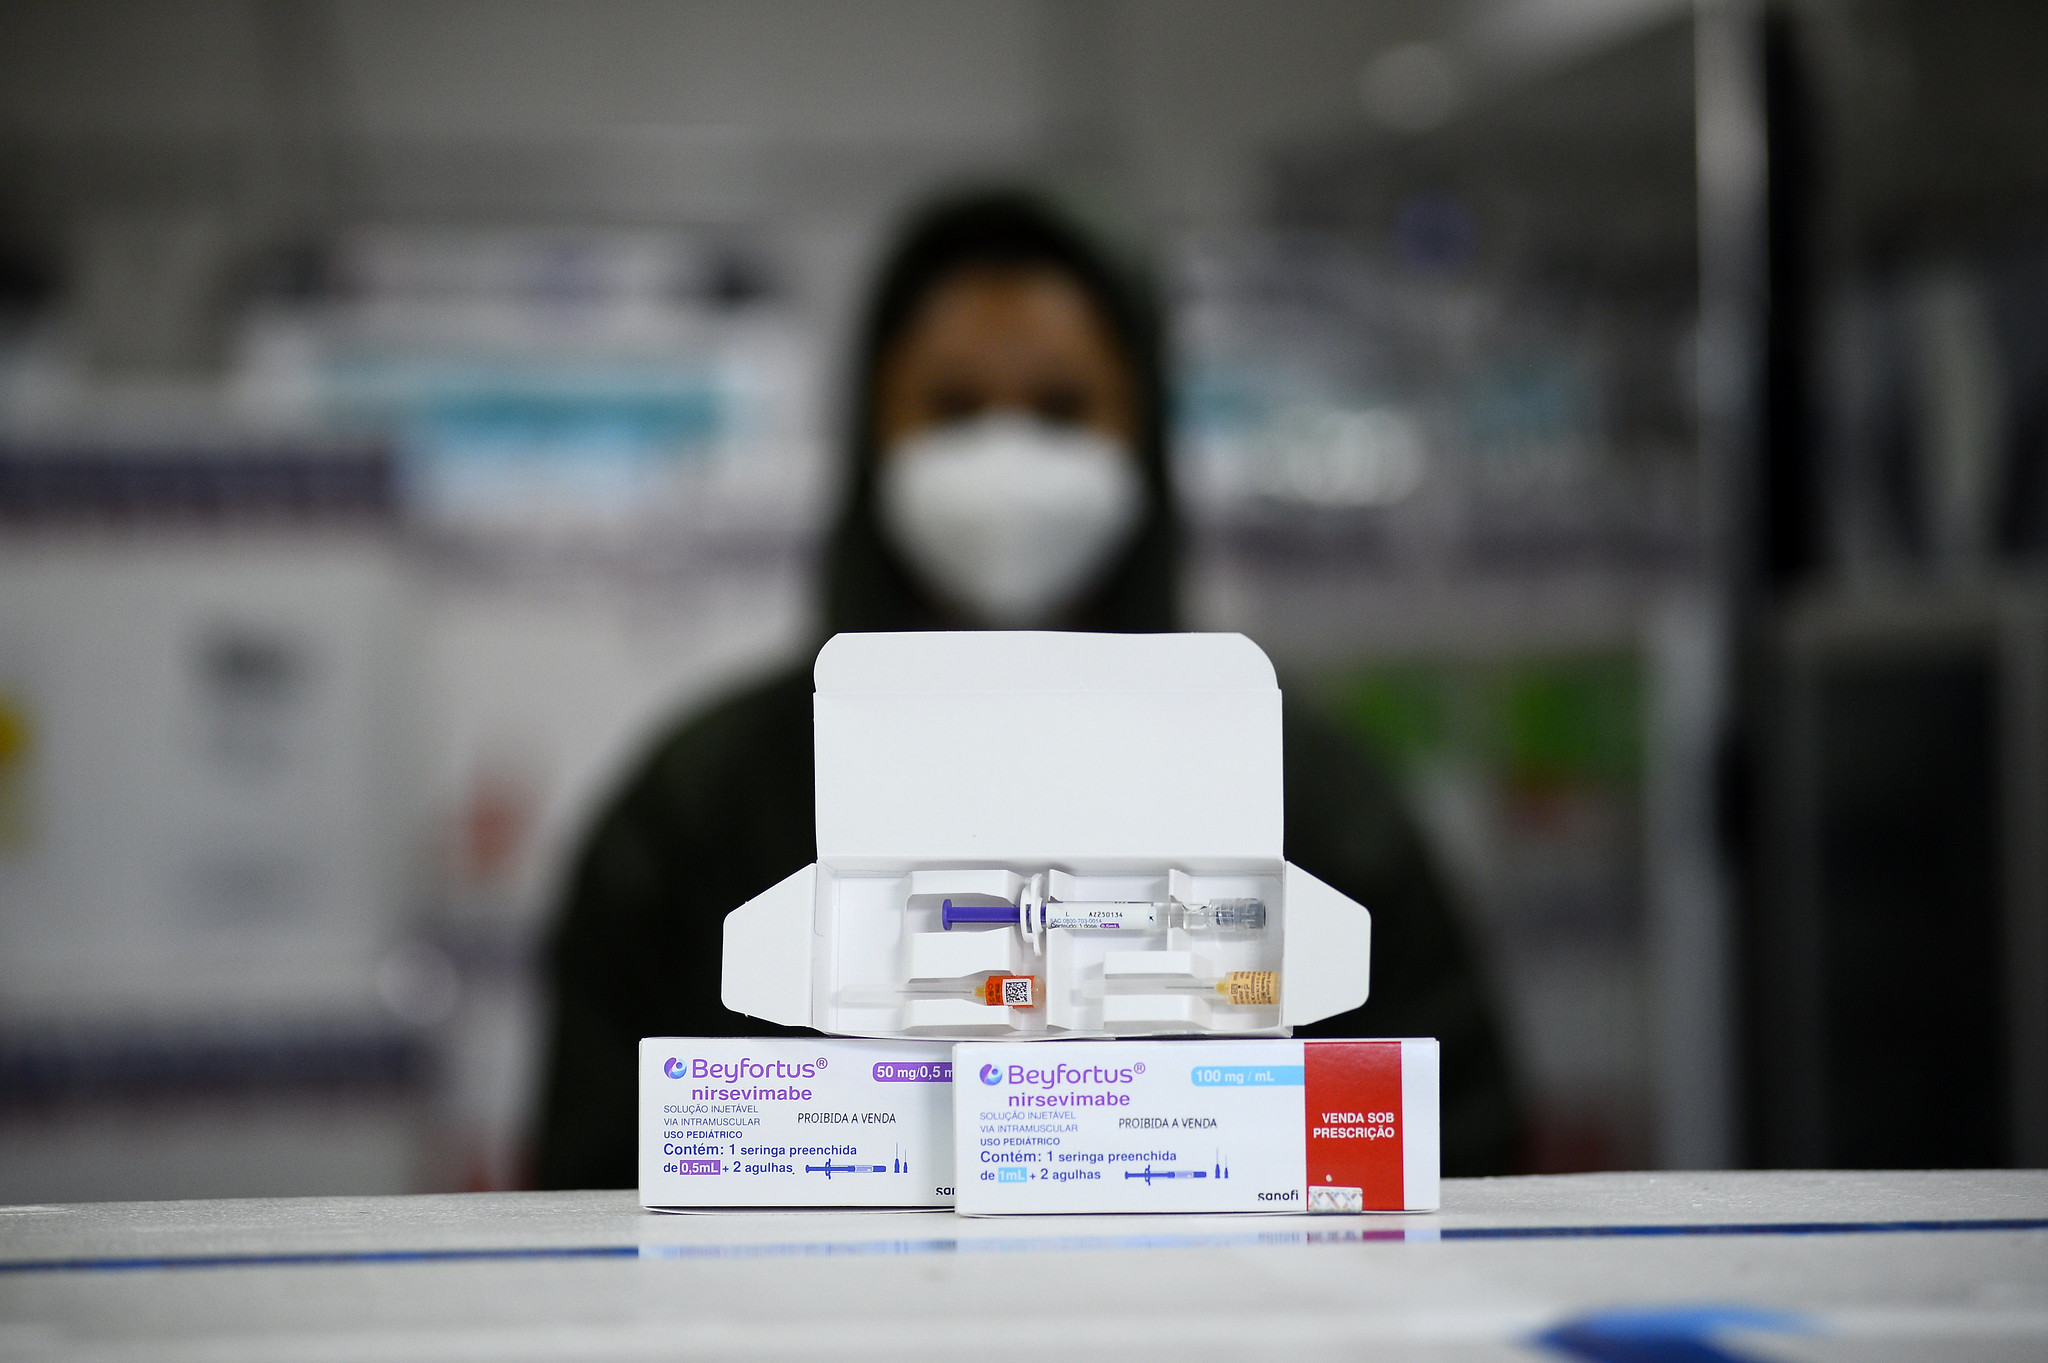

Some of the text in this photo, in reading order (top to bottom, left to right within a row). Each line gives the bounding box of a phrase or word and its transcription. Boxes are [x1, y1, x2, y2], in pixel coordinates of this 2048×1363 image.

[876, 1065, 894, 1078] 50
[897, 1066, 941, 1081] mg/0,5
[1196, 1070, 1221, 1082] 100
[1224, 1071, 1244, 1084] mg
[1255, 1070, 1274, 1082] mL
[692, 1086, 812, 1101] nirsevimabe
[1008, 1091, 1130, 1107] nirsevimabe
[663, 1104, 759, 1115] SOLUÇÃO INJETÁVEL
[663, 1117, 761, 1126] VIA INTRAMUSCULAR
[797, 1113, 897, 1124] PROIBIDA A VENDA
[979, 1110, 1076, 1122] SOLUÇÃO INJETÁVEL
[1322, 1112, 1394, 1123] VENDA SOB
[980, 1124, 1078, 1133] VIA INTRAMUSCULAR
[1118, 1118, 1217, 1129] PROIBIDA A VENDA
[663, 1130, 744, 1140] USO PEDIÁTRICO
[1313, 1125, 1394, 1141] PRESCRIÇÃO
[980, 1137, 1060, 1146] USO PEDIÁTRICO
[663, 1143, 857, 1158] Contém: 1 seringa preenchida
[980, 1150, 1177, 1164] Contém: 1 seringa preenchida
[663, 1163, 678, 1173] de
[681, 1163, 718, 1174] 0,5mL
[733, 1162, 741, 1173] 2
[980, 1170, 995, 1181] de
[999, 1170, 1026, 1181] 1mL
[1040, 1168, 1048, 1179] 2
[1052, 1168, 1101, 1182] agulhas
[1257, 1190, 1299, 1201] sanofi
